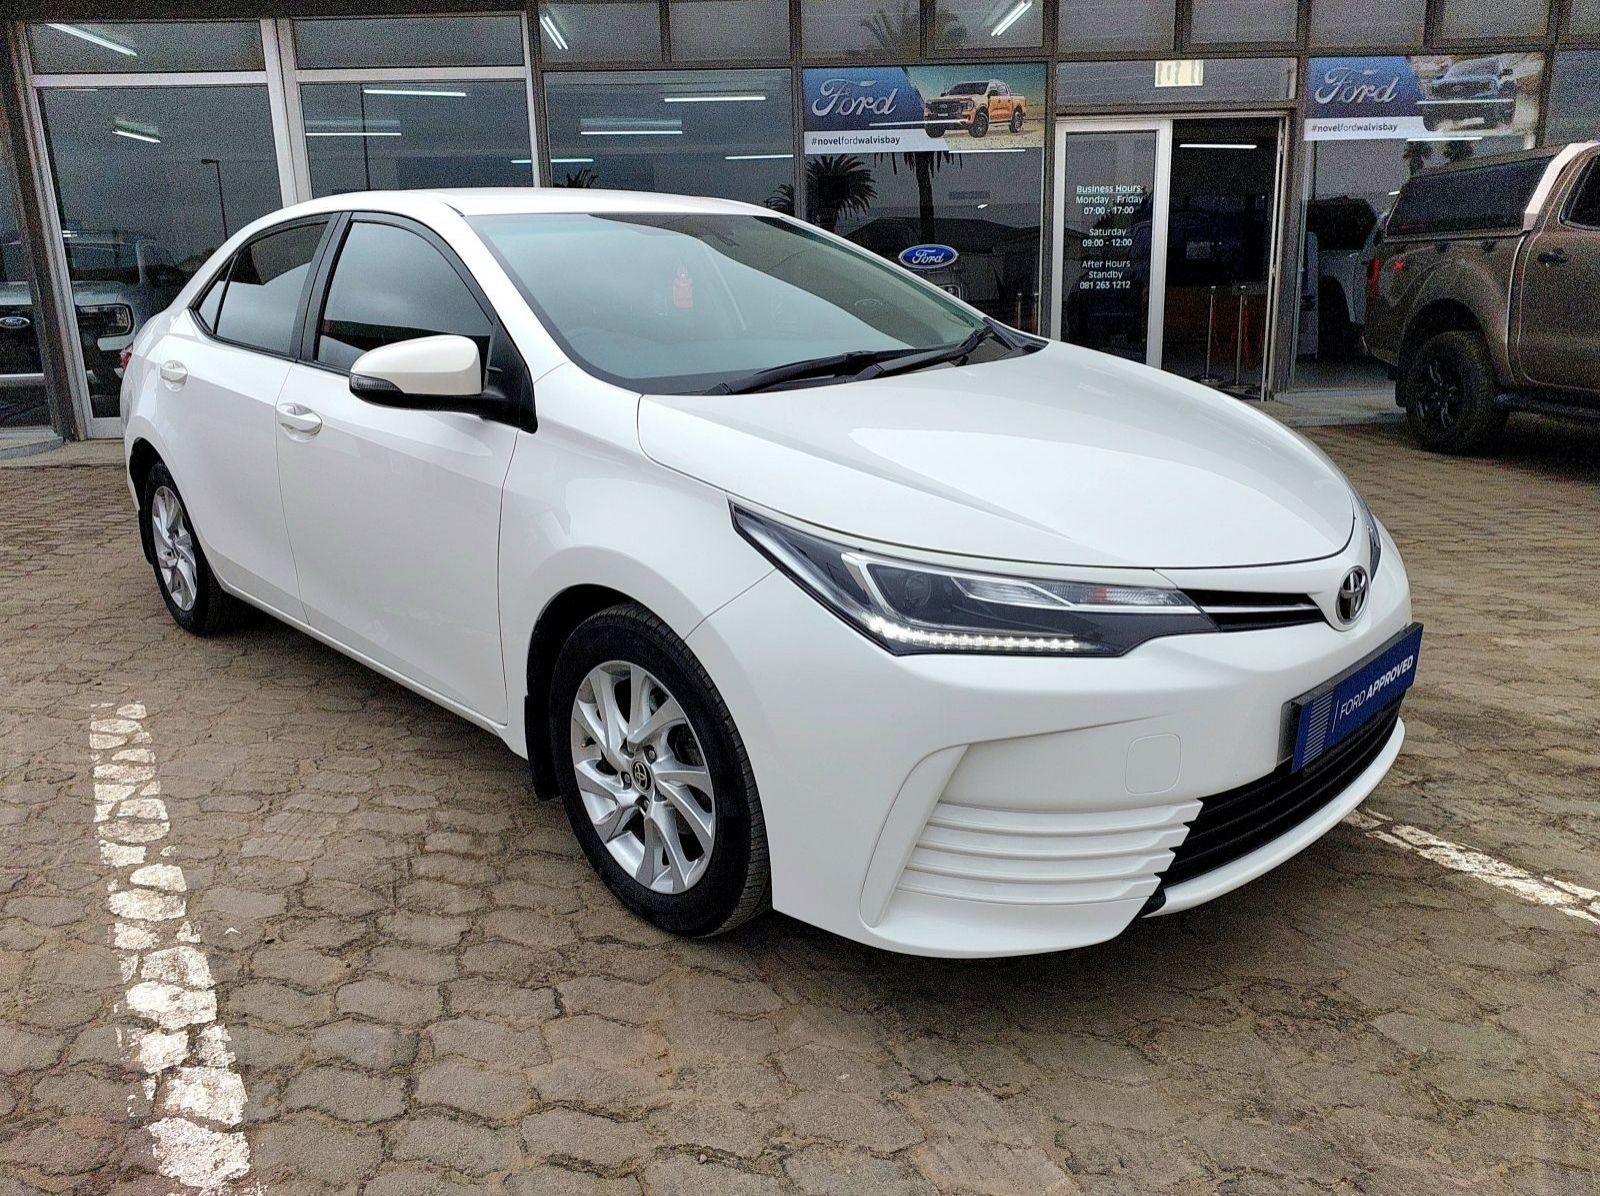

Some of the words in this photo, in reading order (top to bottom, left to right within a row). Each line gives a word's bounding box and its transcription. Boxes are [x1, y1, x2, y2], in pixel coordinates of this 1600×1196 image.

[1315, 67, 1399, 104] Ford
[811, 78, 897, 117] Ford
[1311, 122, 1398, 133] #novelfordwalvisbay
[811, 135, 900, 146] #novelfordwalvisbay
[1076, 185, 1114, 194] Business
[1115, 184, 1143, 193] Hours:
[1075, 195, 1110, 204] Monday
[1117, 195, 1143, 204] Friday
[1083, 206, 1106, 215] 07:00
[1112, 206, 1135, 214] 17:00
[1089, 228, 1127, 237] Saturday
[1082, 239, 1104, 247] 09:00
[1111, 238, 1133, 246] 12:00
[911, 249, 945, 264] Ford
[1081, 260, 1104, 268] After
[1105, 260, 1131, 268] Hours
[1088, 270, 1123, 279] Standby
[1079, 281, 1094, 290] 081
[1096, 281, 1110, 289] 263
[1112, 281, 1131, 289] 1212
[1339, 689, 1366, 721] FORD
[1365, 655, 1414, 701] APPROVED
